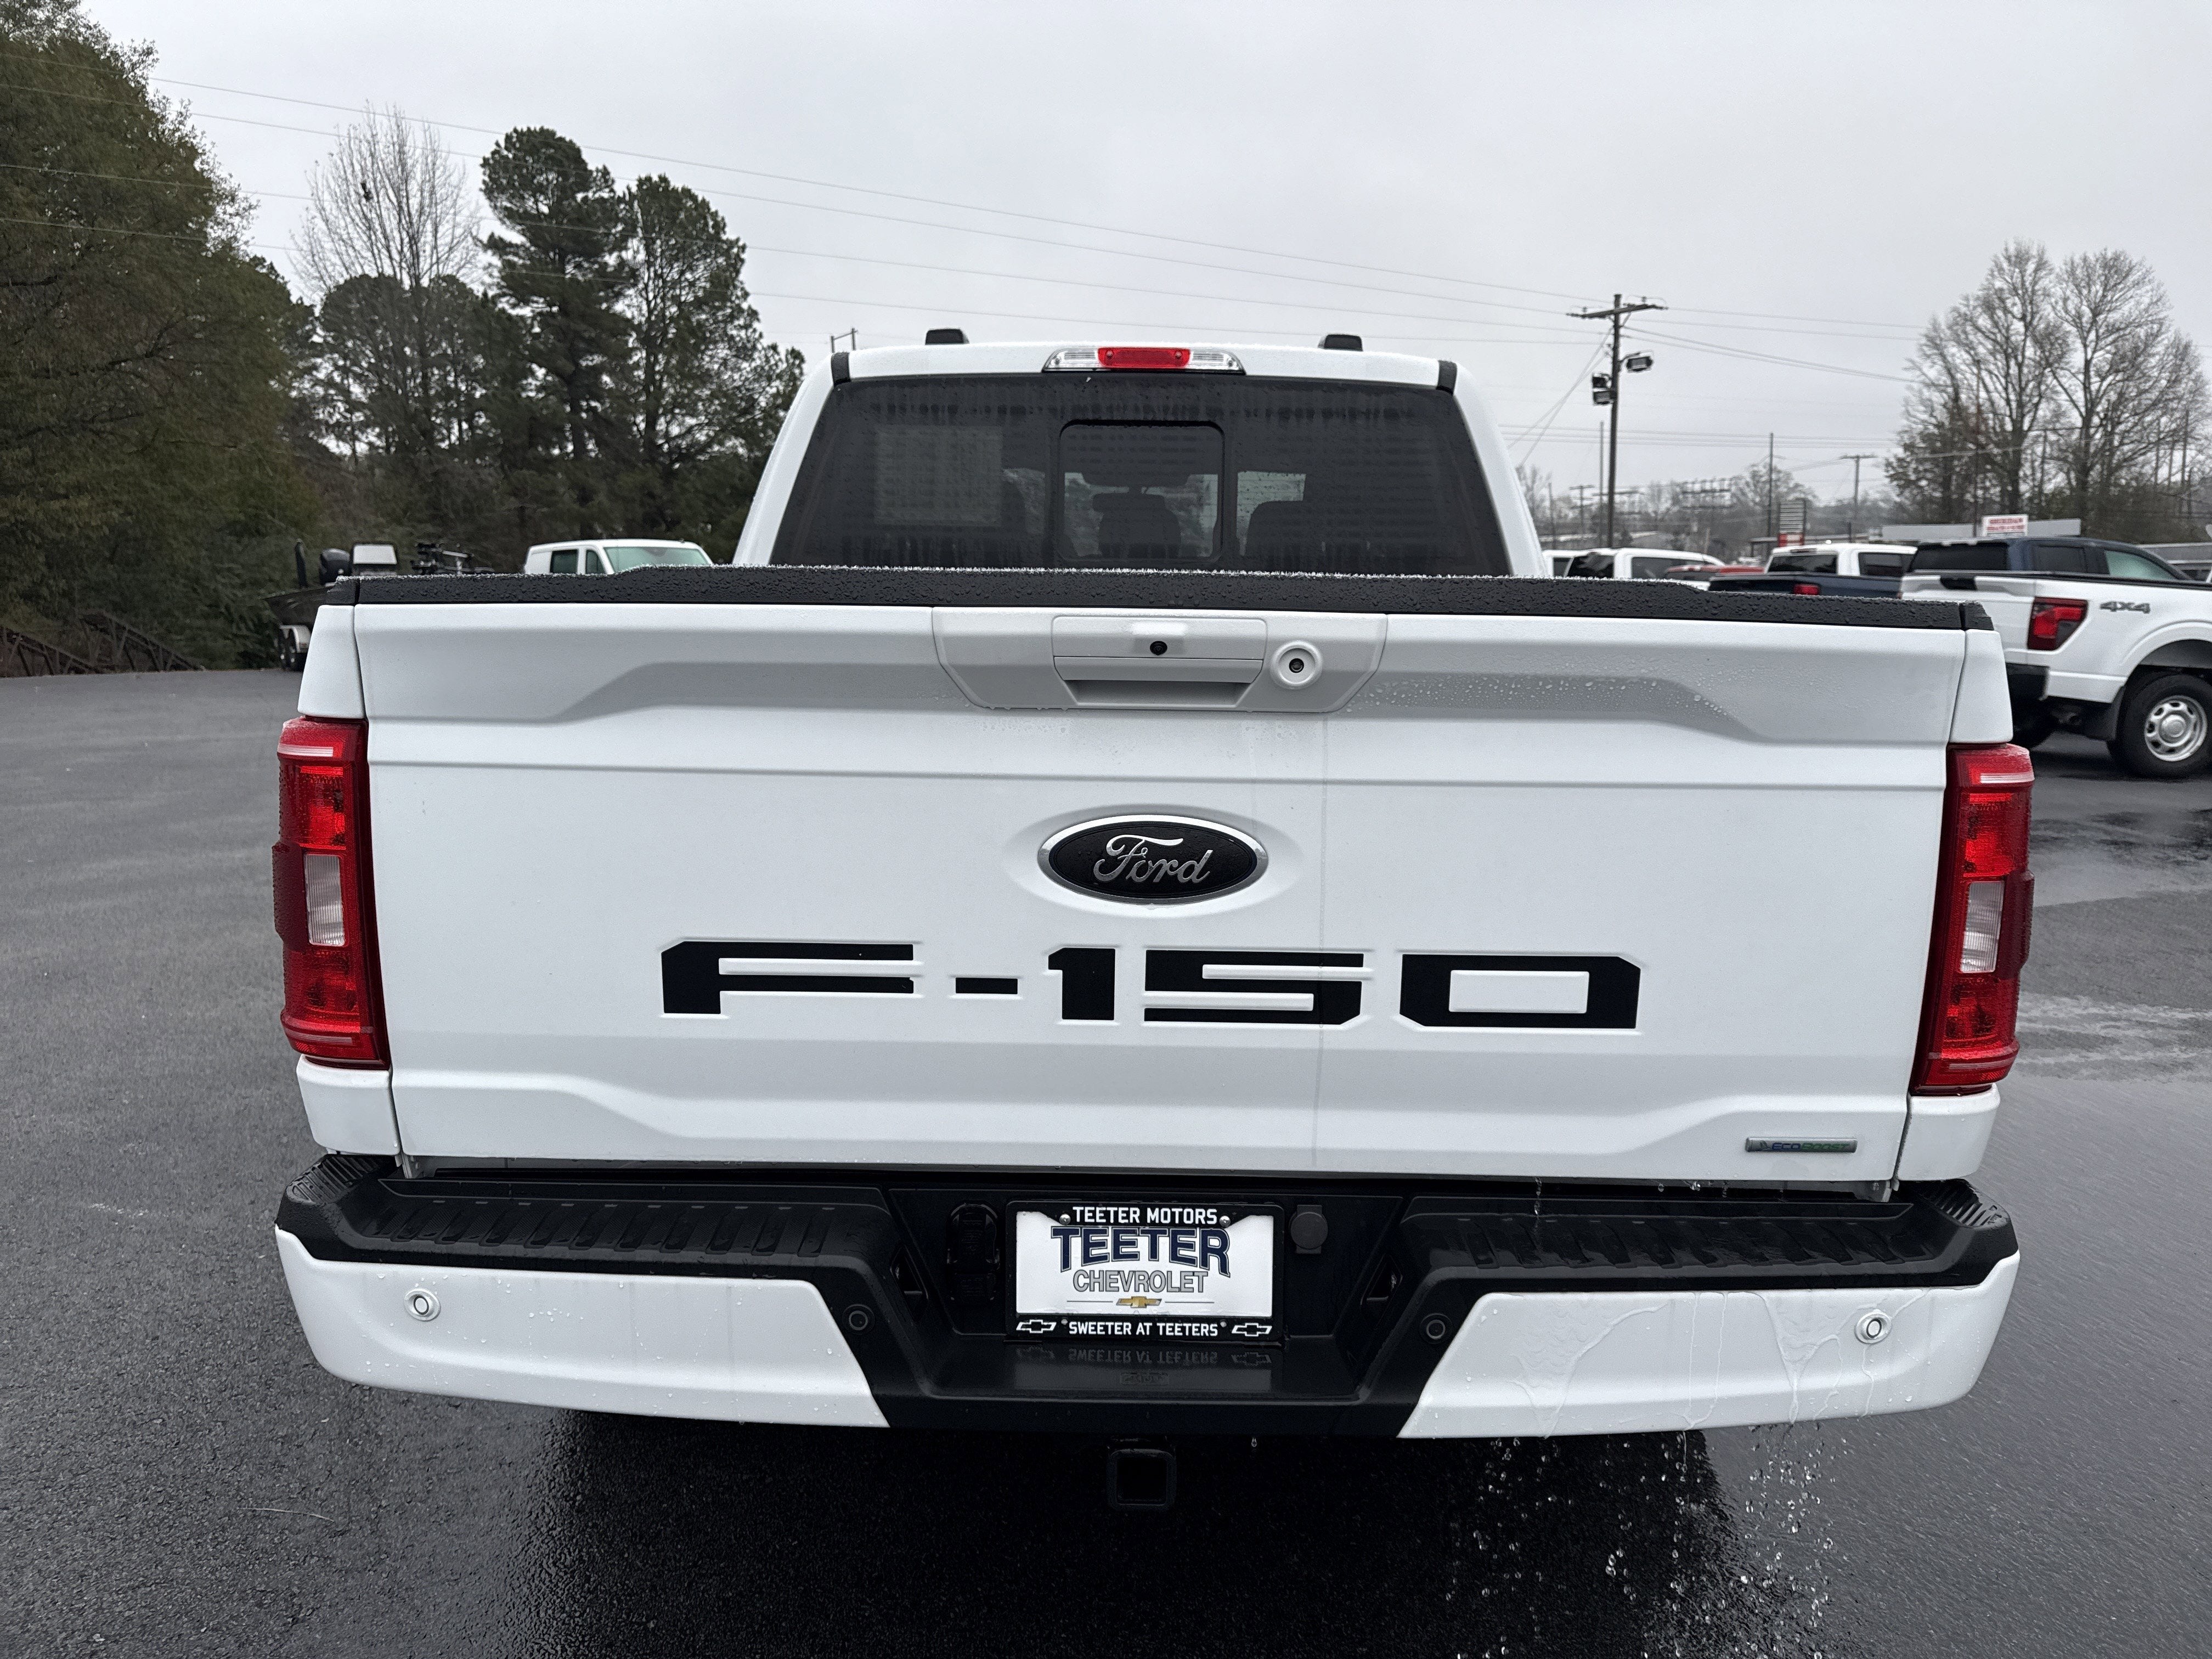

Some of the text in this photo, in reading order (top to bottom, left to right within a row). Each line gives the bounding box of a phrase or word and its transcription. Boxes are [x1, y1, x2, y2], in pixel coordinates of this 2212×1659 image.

[1093, 834, 1213, 883] Ford
[661, 940, 1641, 1029] F-150
[1073, 1207, 1217, 1225] TEETER MOTORS
[1051, 1226, 1231, 1278] TEETER
[1073, 1270, 1208, 1293] CHEVROLET
[1069, 1321, 1218, 1336] SWEETER AT TEETERS
